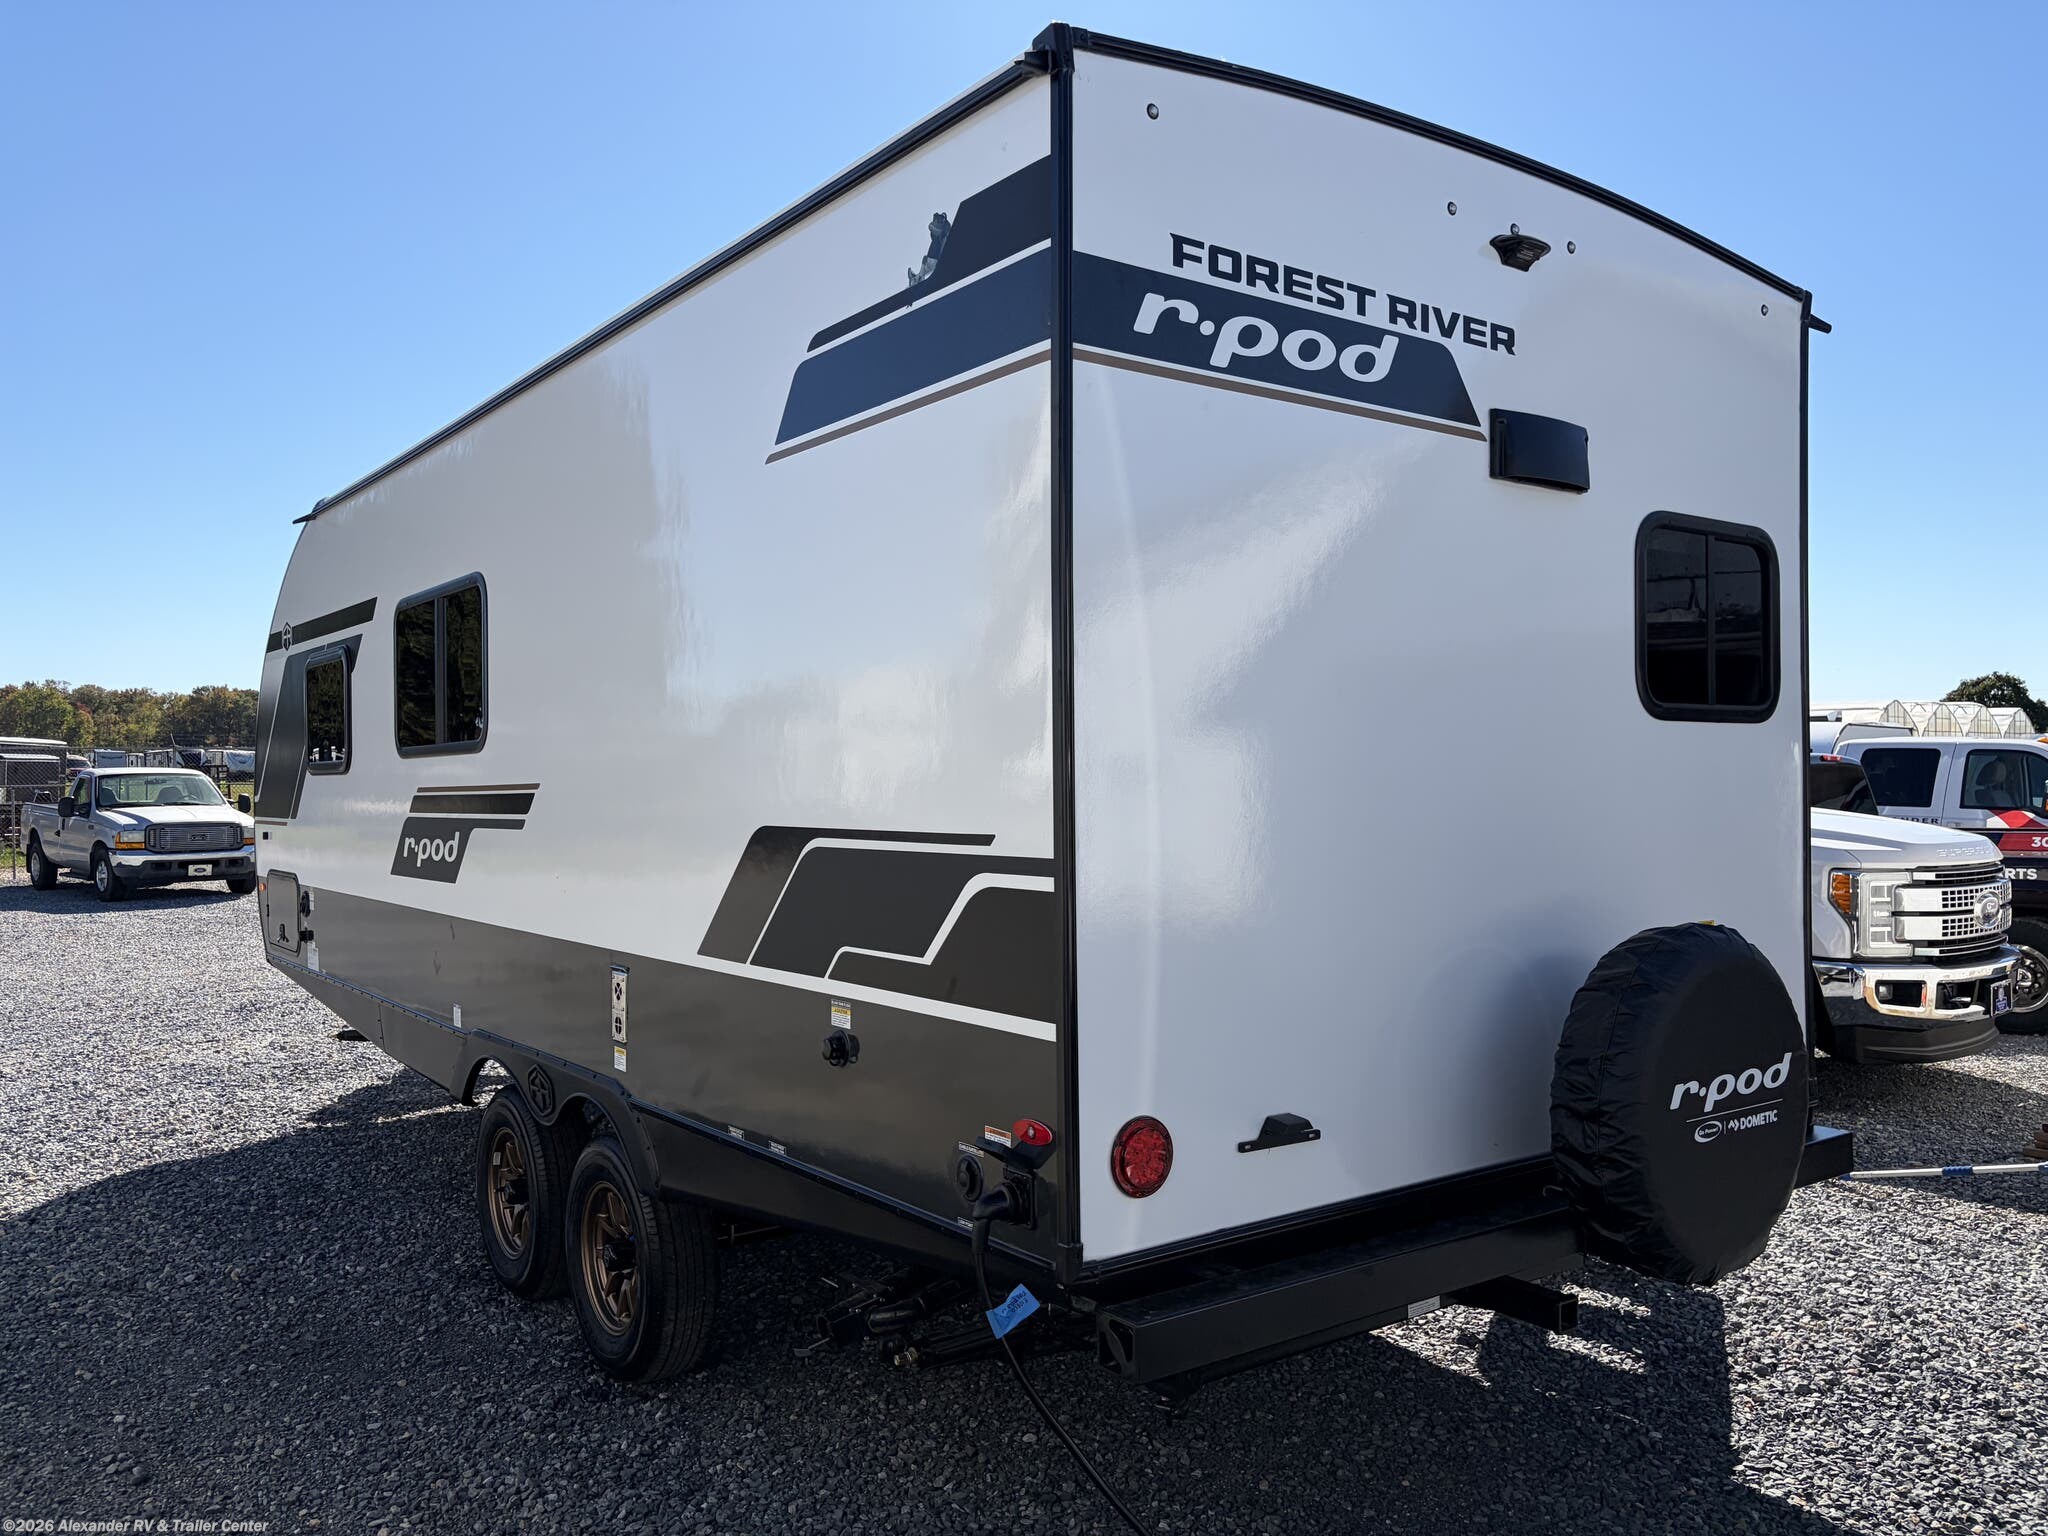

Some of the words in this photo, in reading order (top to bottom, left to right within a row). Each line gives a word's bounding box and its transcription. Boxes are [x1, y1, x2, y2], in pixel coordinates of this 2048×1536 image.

[1169, 232, 1376, 317] FOREST
[1386, 293, 1517, 356] RIVER
[1740, 1109, 1778, 1130] DOMETIC
